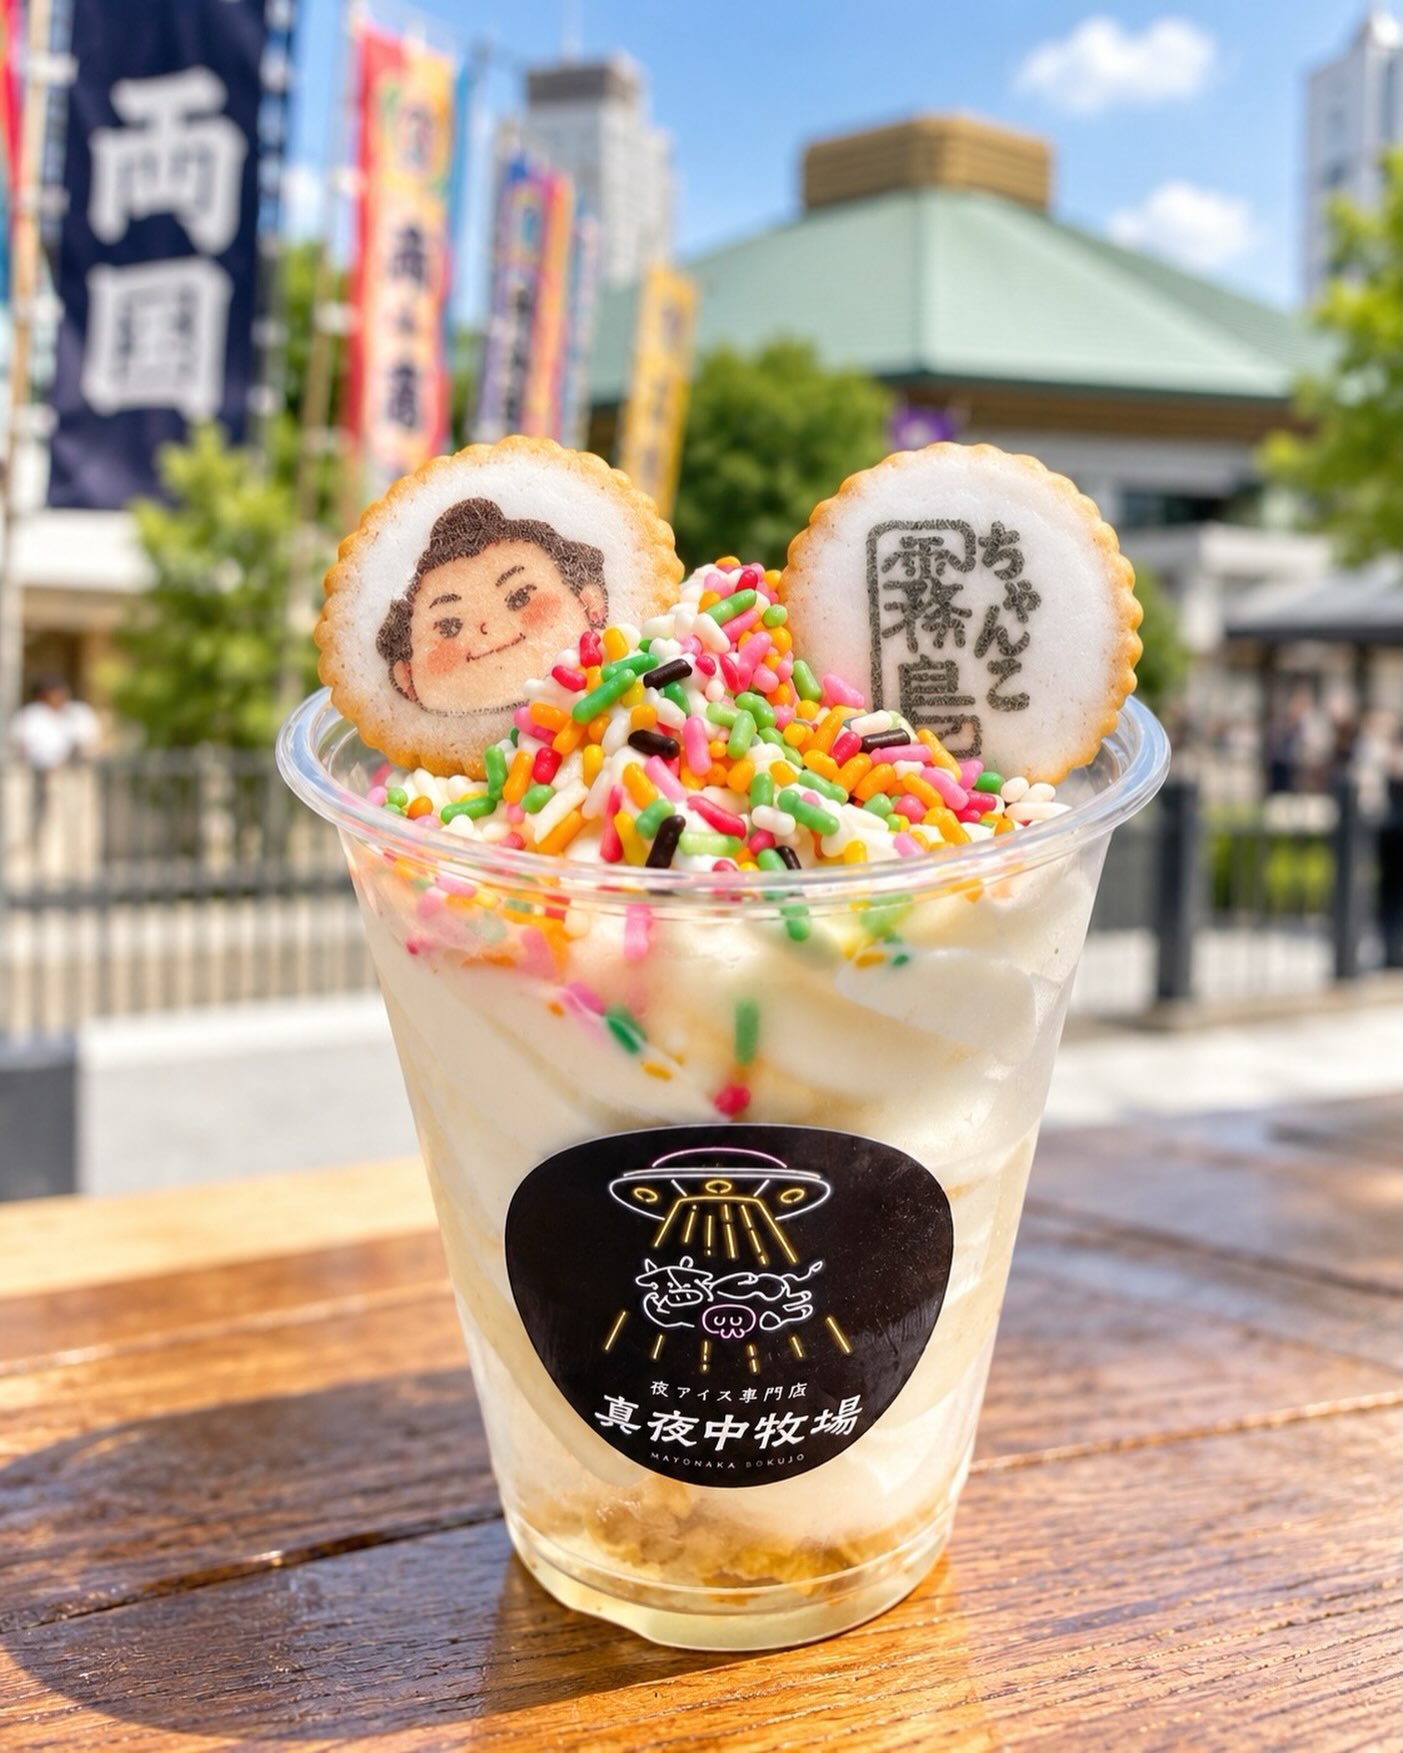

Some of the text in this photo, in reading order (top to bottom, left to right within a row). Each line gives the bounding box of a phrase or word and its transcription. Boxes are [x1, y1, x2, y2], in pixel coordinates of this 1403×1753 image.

[84, 66, 247, 420] 両国
[880, 535, 983, 758] 霧島
[974, 520, 1042, 712] ちゃんこ
[594, 1394, 863, 1451] 真夜中牧場
[650, 1380, 808, 1404] 夜アイス専門店
[650, 1451, 805, 1469] MAYONAKA BOKUJO
